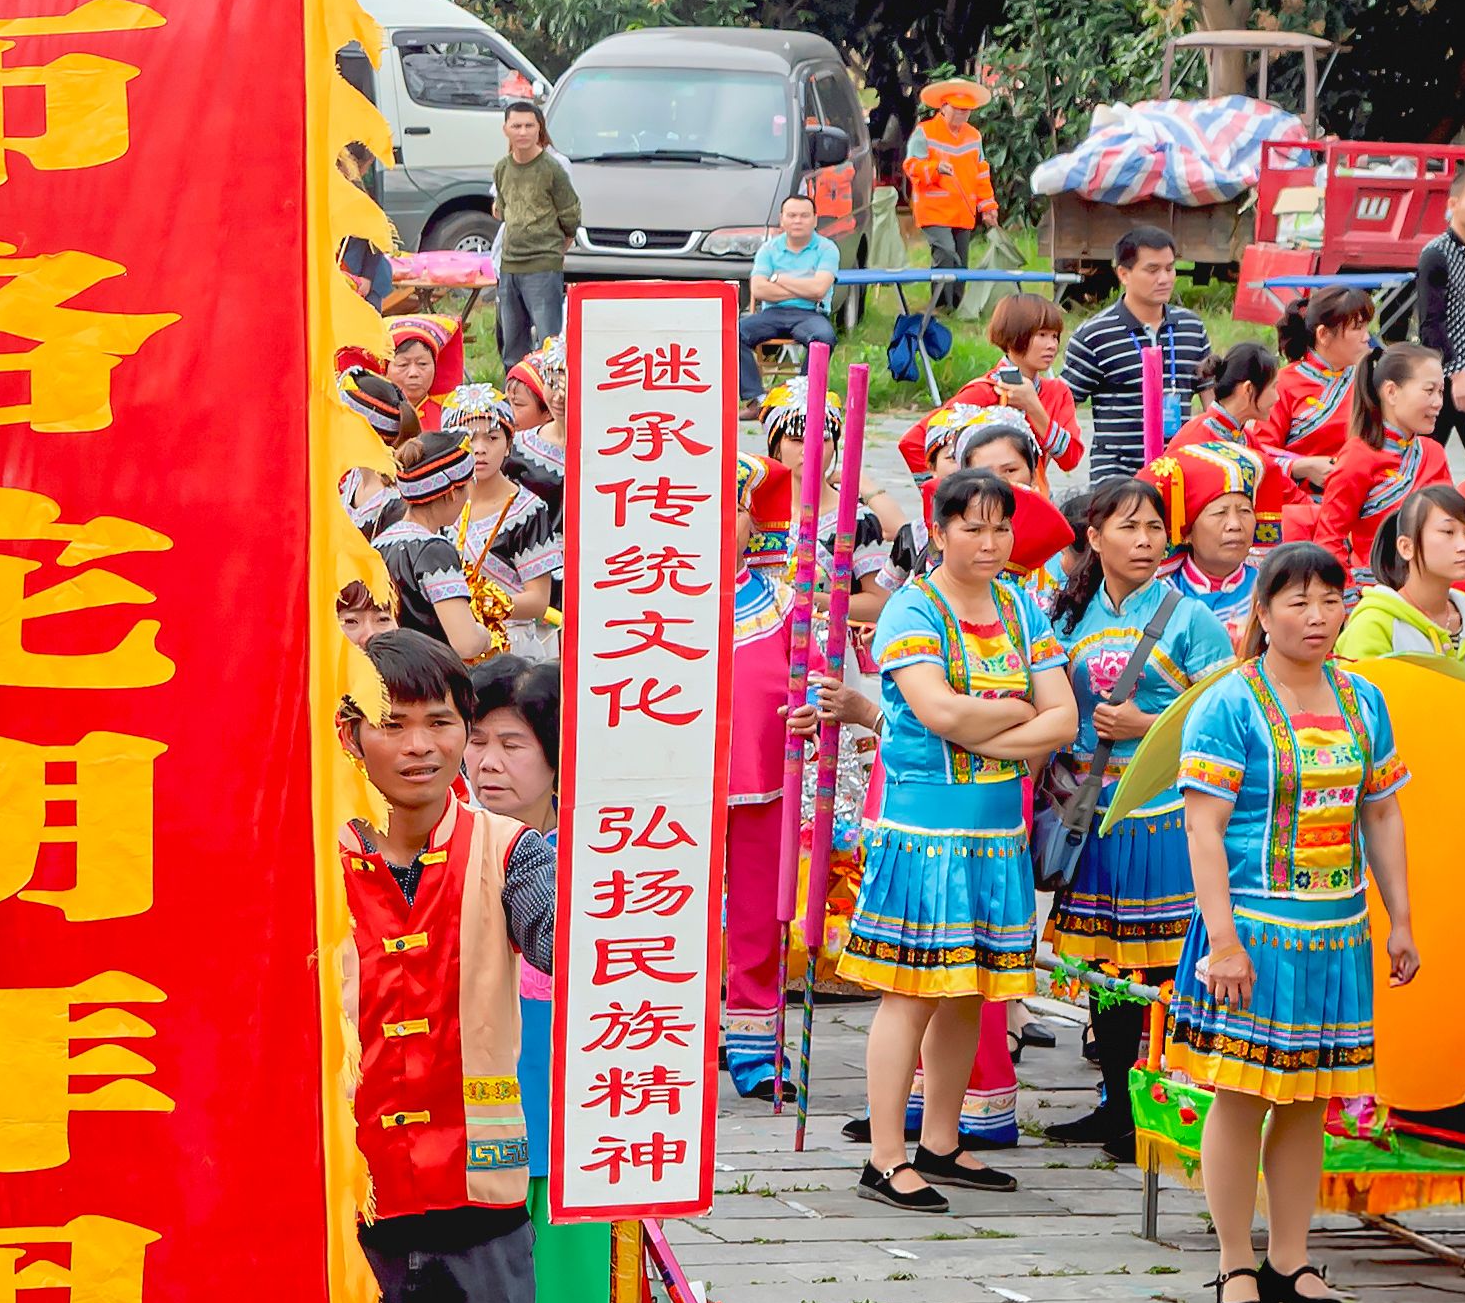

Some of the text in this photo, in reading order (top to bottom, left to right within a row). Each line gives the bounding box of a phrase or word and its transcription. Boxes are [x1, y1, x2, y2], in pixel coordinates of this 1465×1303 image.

[579, 343, 715, 1185] 继承传统文化 弘扬民族精神
